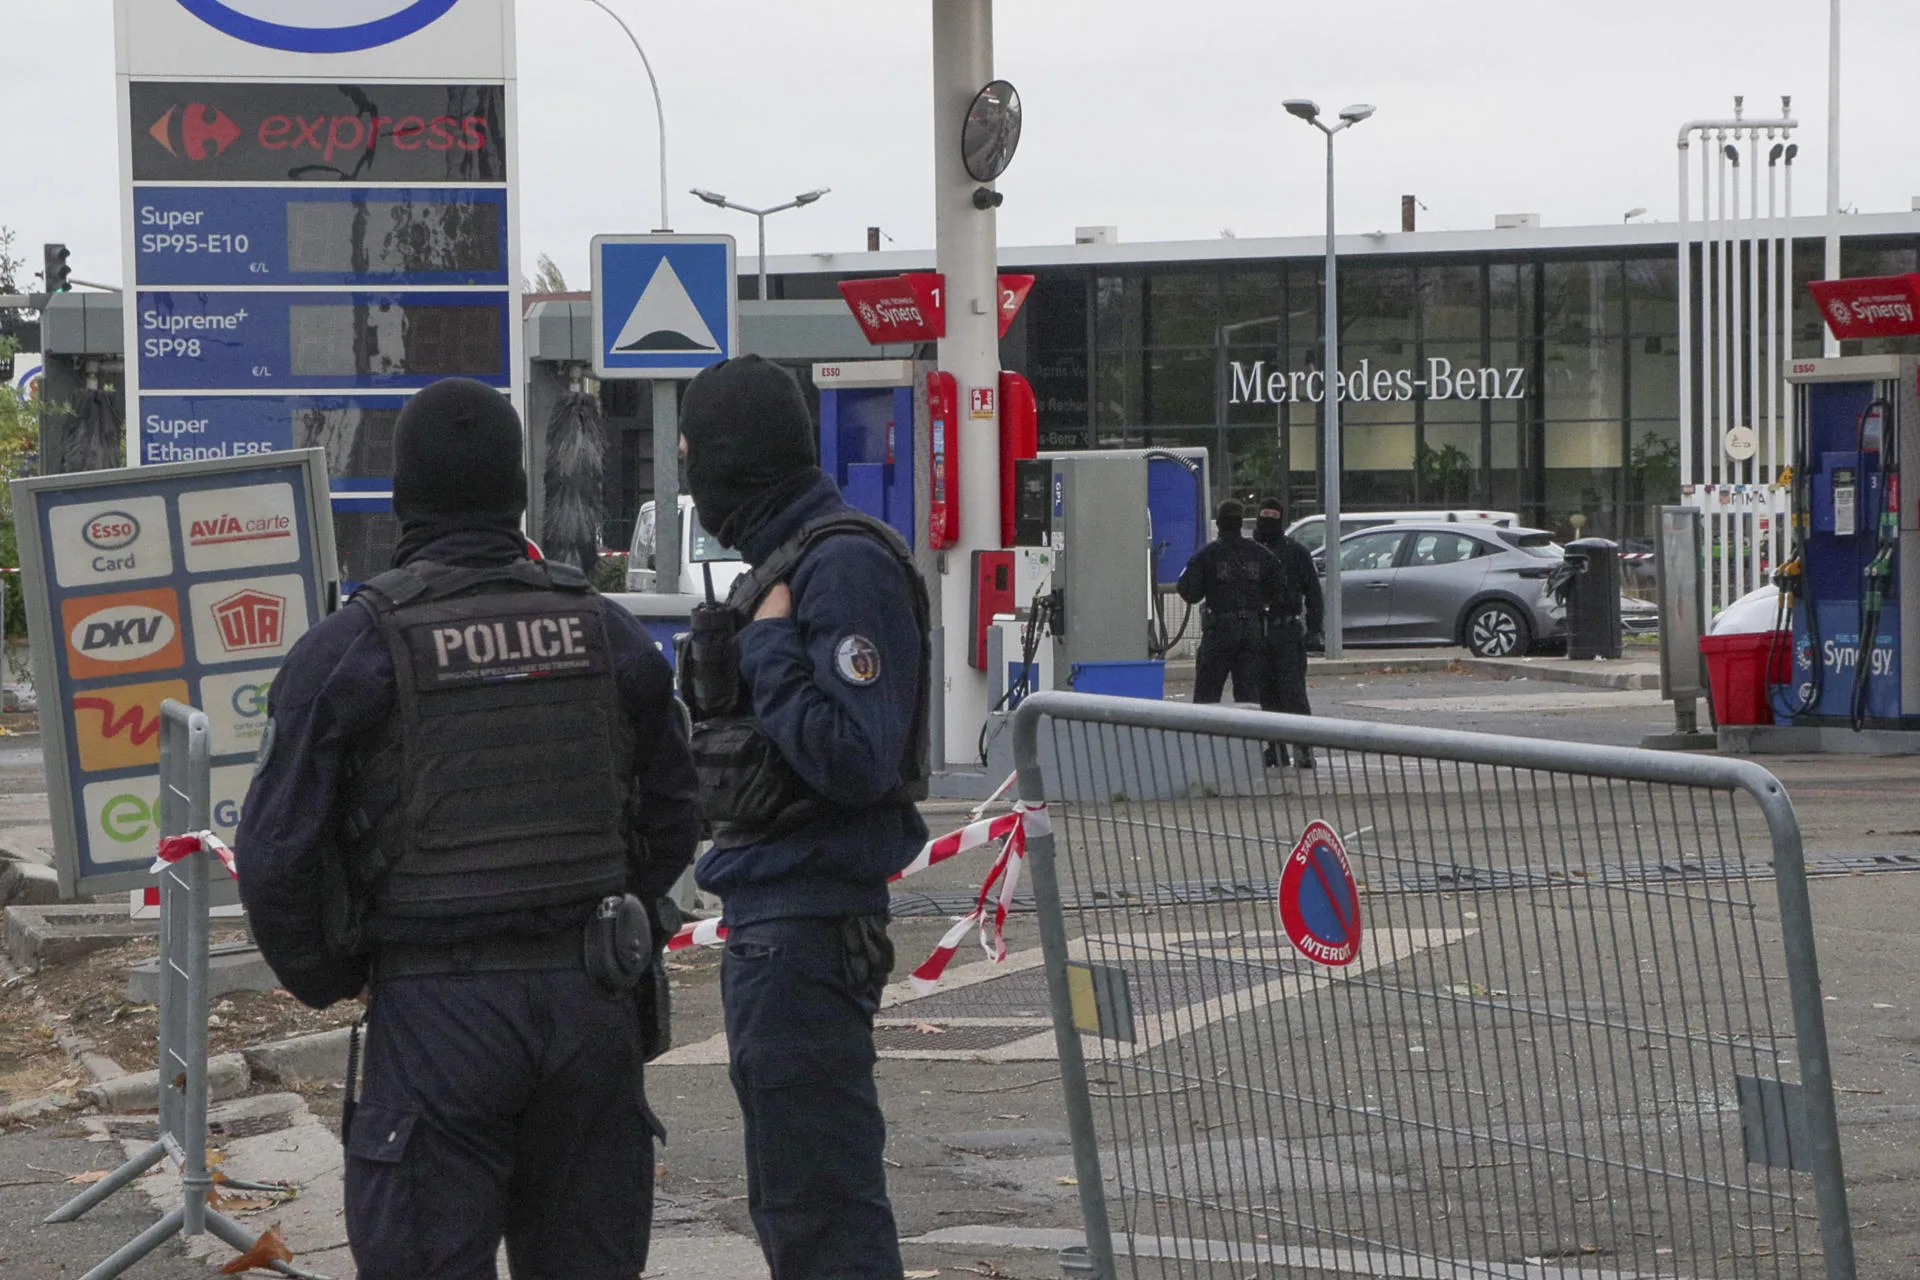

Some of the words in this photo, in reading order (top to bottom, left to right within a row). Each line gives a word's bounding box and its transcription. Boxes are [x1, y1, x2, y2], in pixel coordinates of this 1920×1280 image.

[258, 112, 488, 162] express
[140, 206, 204, 230] Super
[142, 234, 249, 253] SP95-E10
[250, 262, 269, 273] €/L
[931, 288, 940, 308] 1
[1003, 290, 1015, 309] 2
[144, 308, 248, 334] Supreme+
[1851, 301, 1914, 324] Synergy
[144, 338, 201, 358] SP98
[252, 366, 272, 377] €/L
[822, 368, 840, 377] ESSO
[1793, 364, 1816, 374] ESSO
[146, 415, 209, 438] Super
[147, 442, 226, 461] Ethanol
[91, 522, 132, 540] Esso
[246, 515, 290, 532] carte
[92, 553, 136, 573] Card
[219, 588, 281, 649] UTA
[82, 615, 162, 651] DKV
[432, 616, 586, 667] POLICE
[1824, 640, 1893, 676] Syngy
[1300, 934, 1351, 961] INTERDIT
